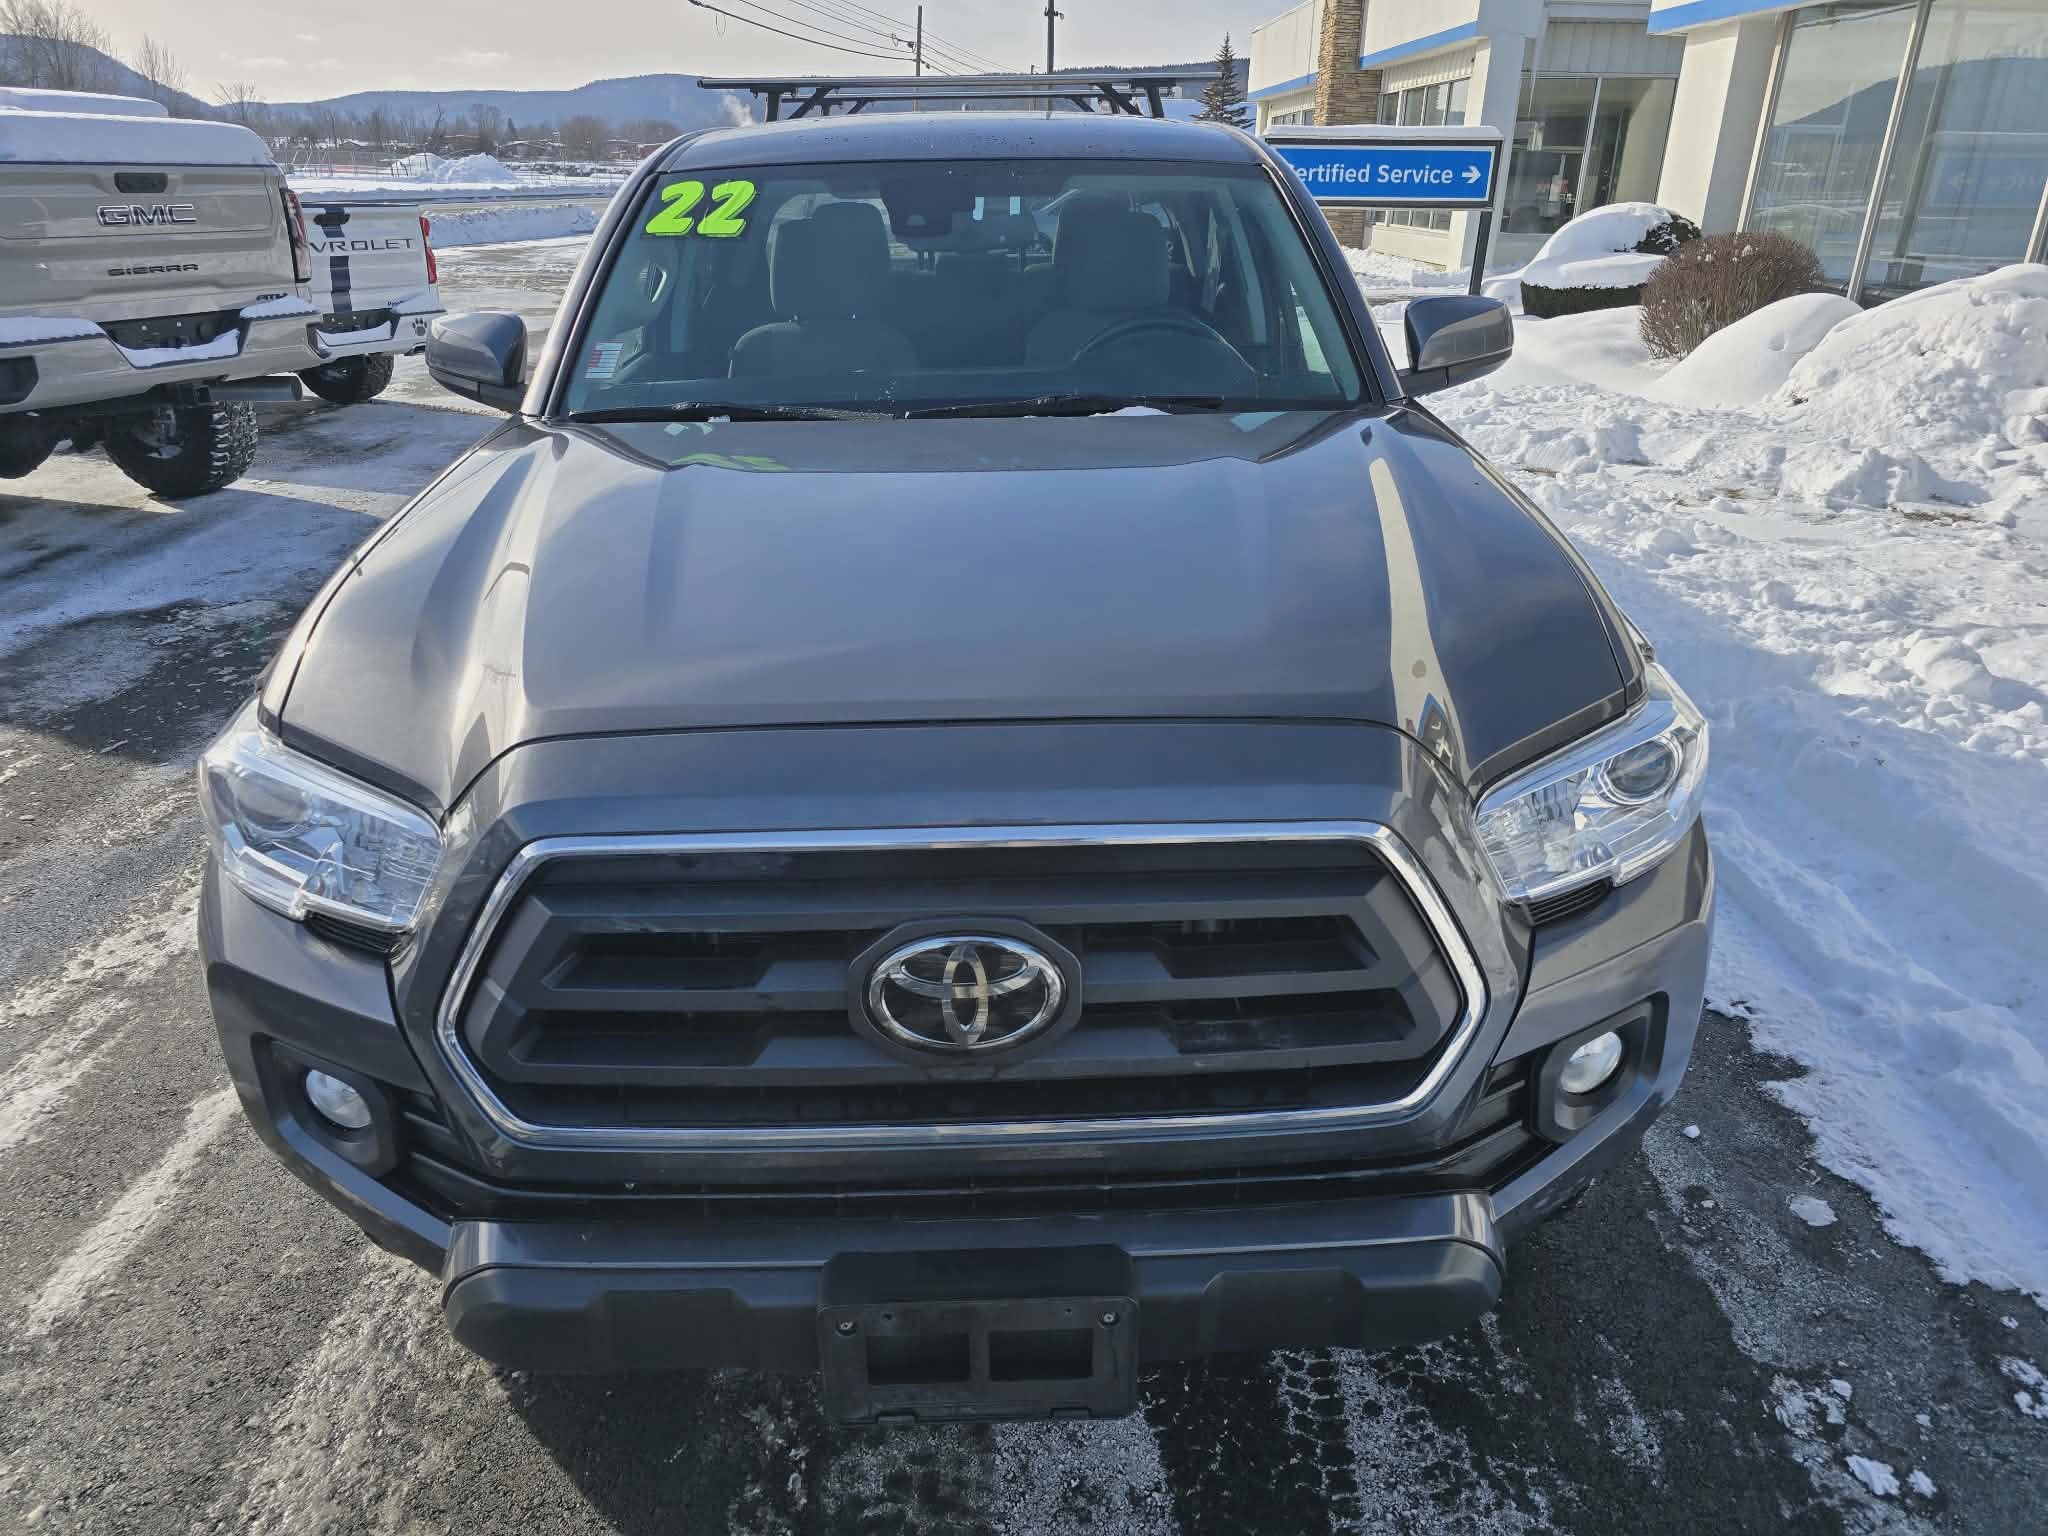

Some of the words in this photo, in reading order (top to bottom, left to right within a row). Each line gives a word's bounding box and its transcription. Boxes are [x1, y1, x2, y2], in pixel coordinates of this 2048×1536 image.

[1377, 164, 1453, 184] Service
[97, 204, 197, 226] GMC
[645, 180, 757, 238] 22
[308, 238, 414, 253] VROLET
[107, 264, 199, 276] SIERRA
